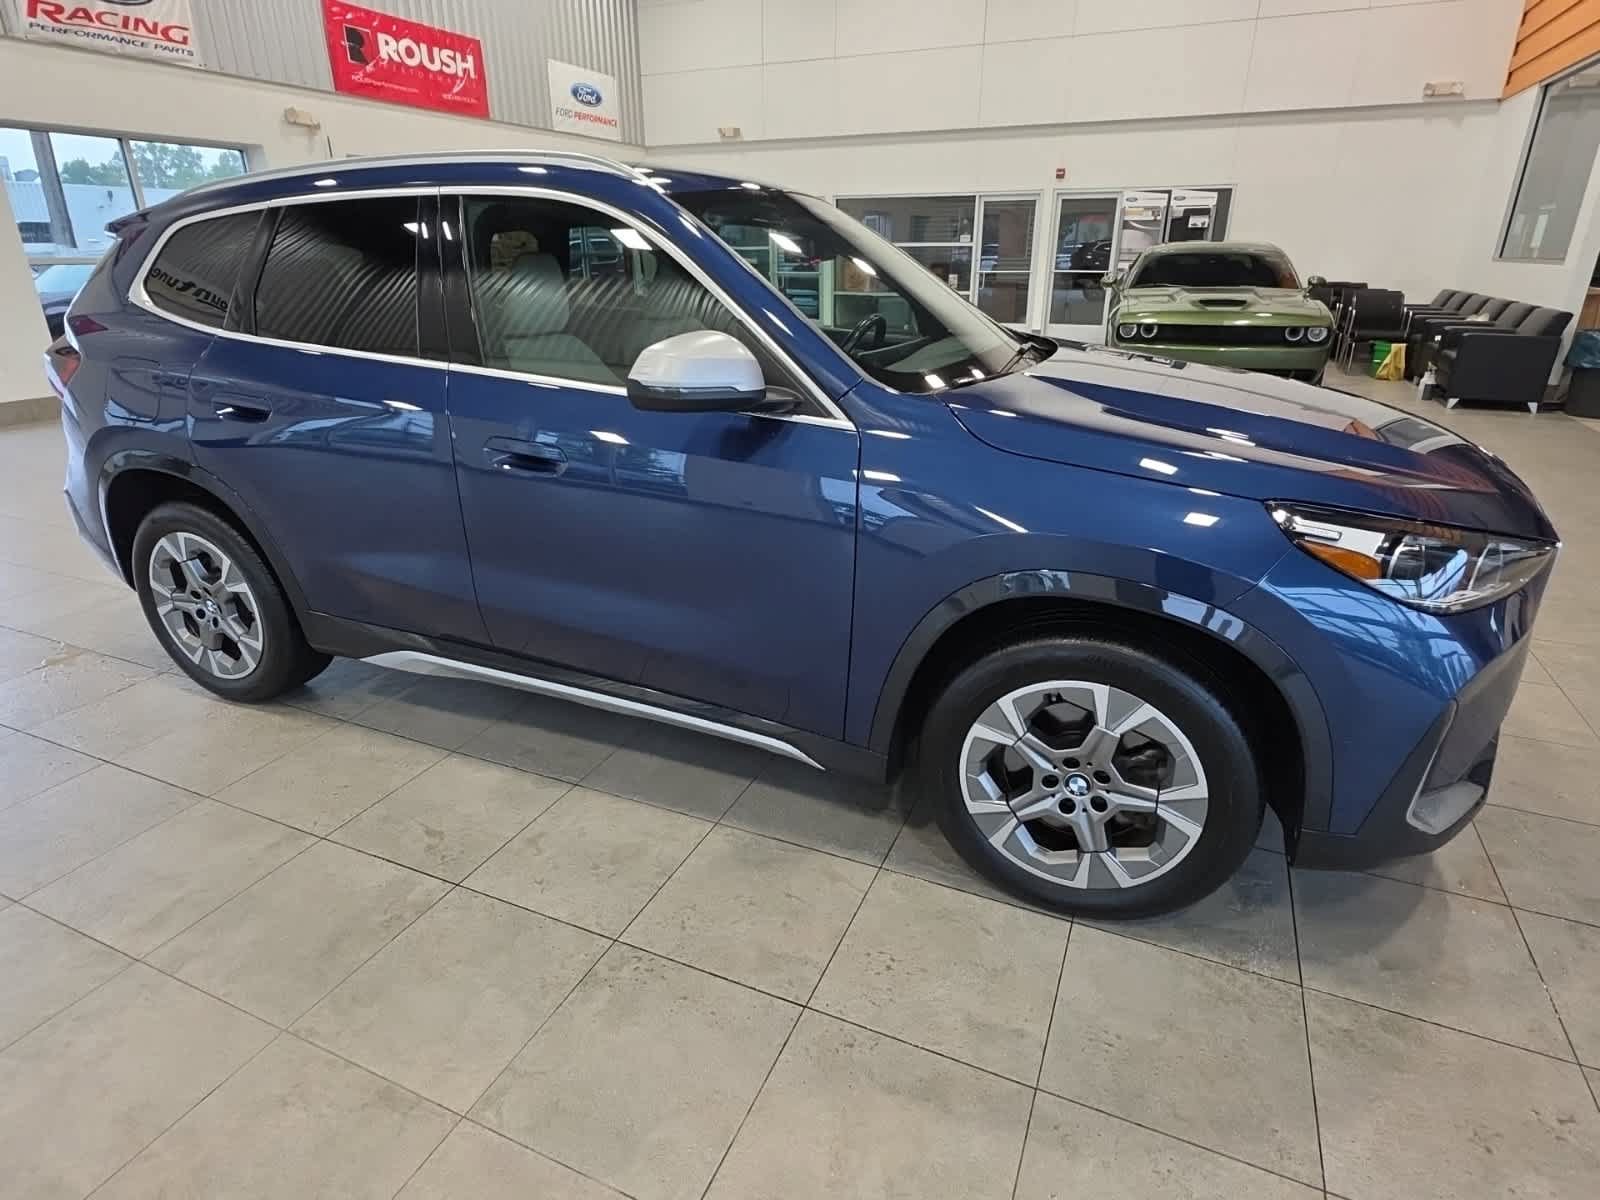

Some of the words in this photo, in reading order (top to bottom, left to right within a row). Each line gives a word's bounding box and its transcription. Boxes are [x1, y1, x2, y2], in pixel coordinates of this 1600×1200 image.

[27, 0, 190, 45] RACING
[29, 22, 149, 49] PERFORMANCE
[154, 43, 195, 57] PARTS
[377, 32, 476, 79] ROUSH
[574, 111, 618, 128] PERFORMANCE
